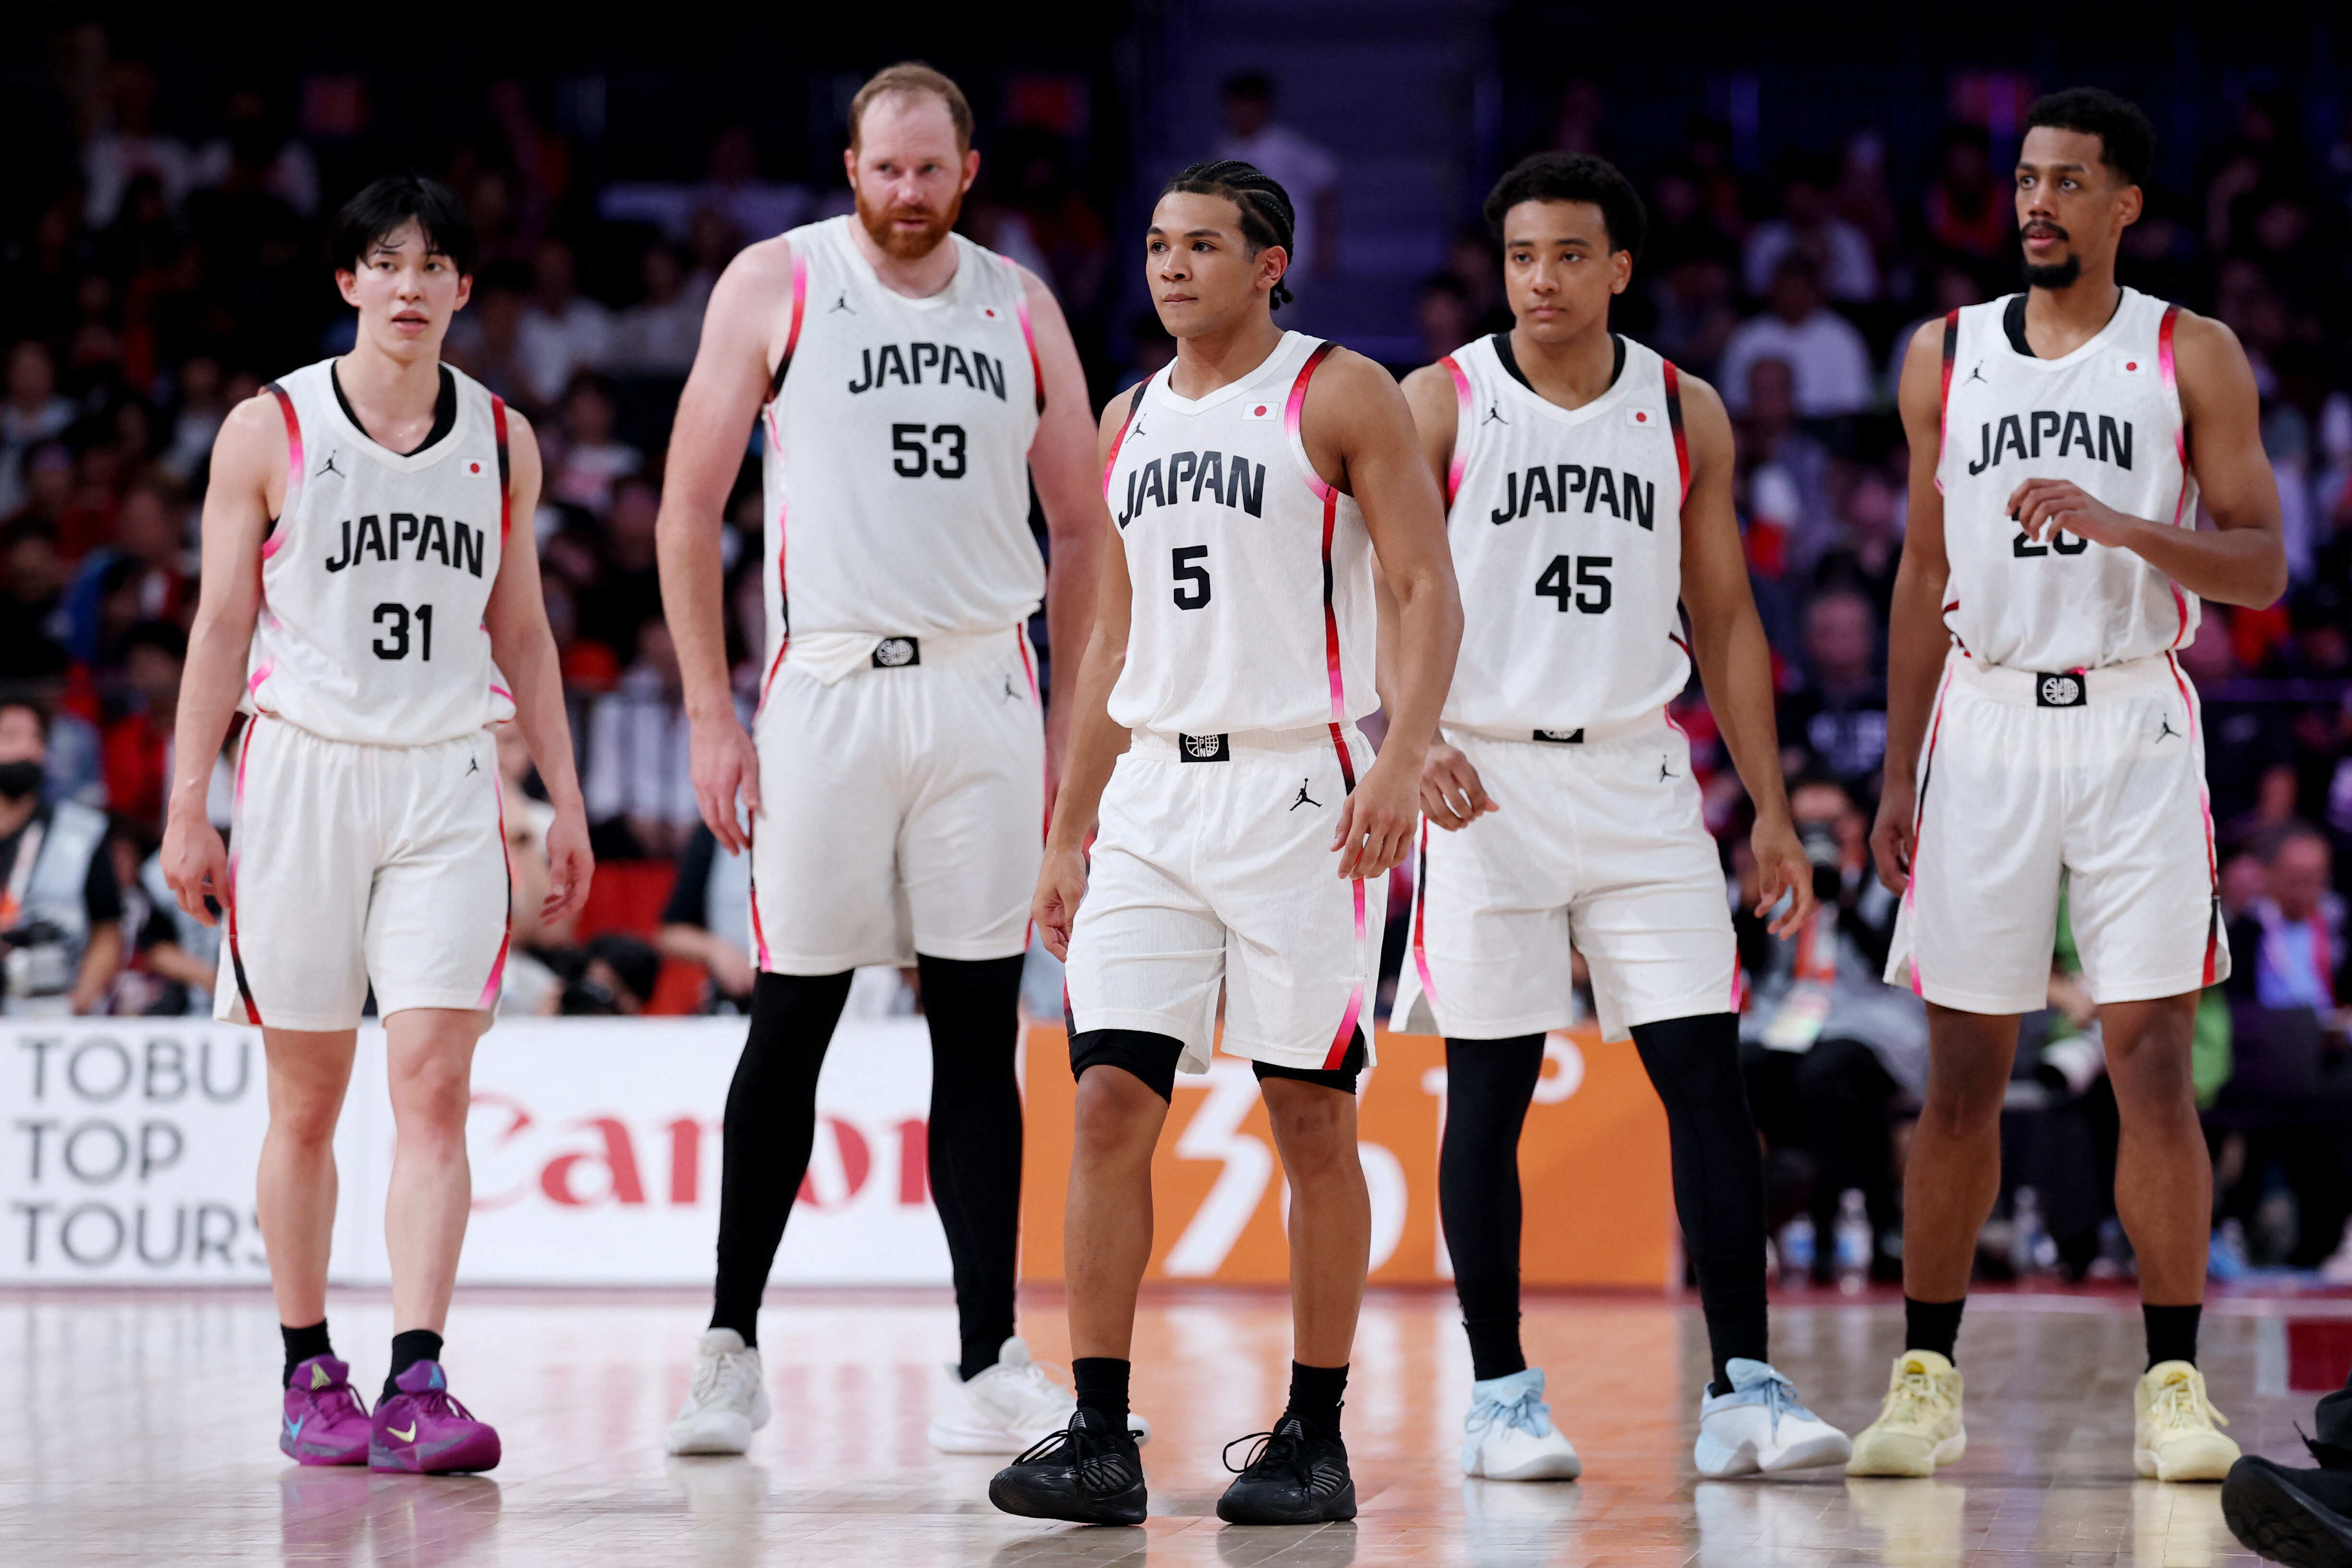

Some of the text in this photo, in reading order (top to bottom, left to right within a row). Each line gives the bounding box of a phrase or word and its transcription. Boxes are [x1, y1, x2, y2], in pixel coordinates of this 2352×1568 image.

[848, 343, 1006, 402] JAPAN
[892, 423, 966, 479] 53
[1968, 411, 2133, 476] JAPAN
[1118, 451, 1266, 530] JAPAN
[1491, 465, 1655, 532] JAPAN
[325, 513, 484, 579] JAPAN
[1172, 545, 1212, 611] 5
[1535, 555, 1613, 614] 45
[373, 602, 433, 662] 31
[20, 1037, 250, 1103] TOBU
[16, 1119, 184, 1185] TOP
[12, 1202, 269, 1267] TOUR
